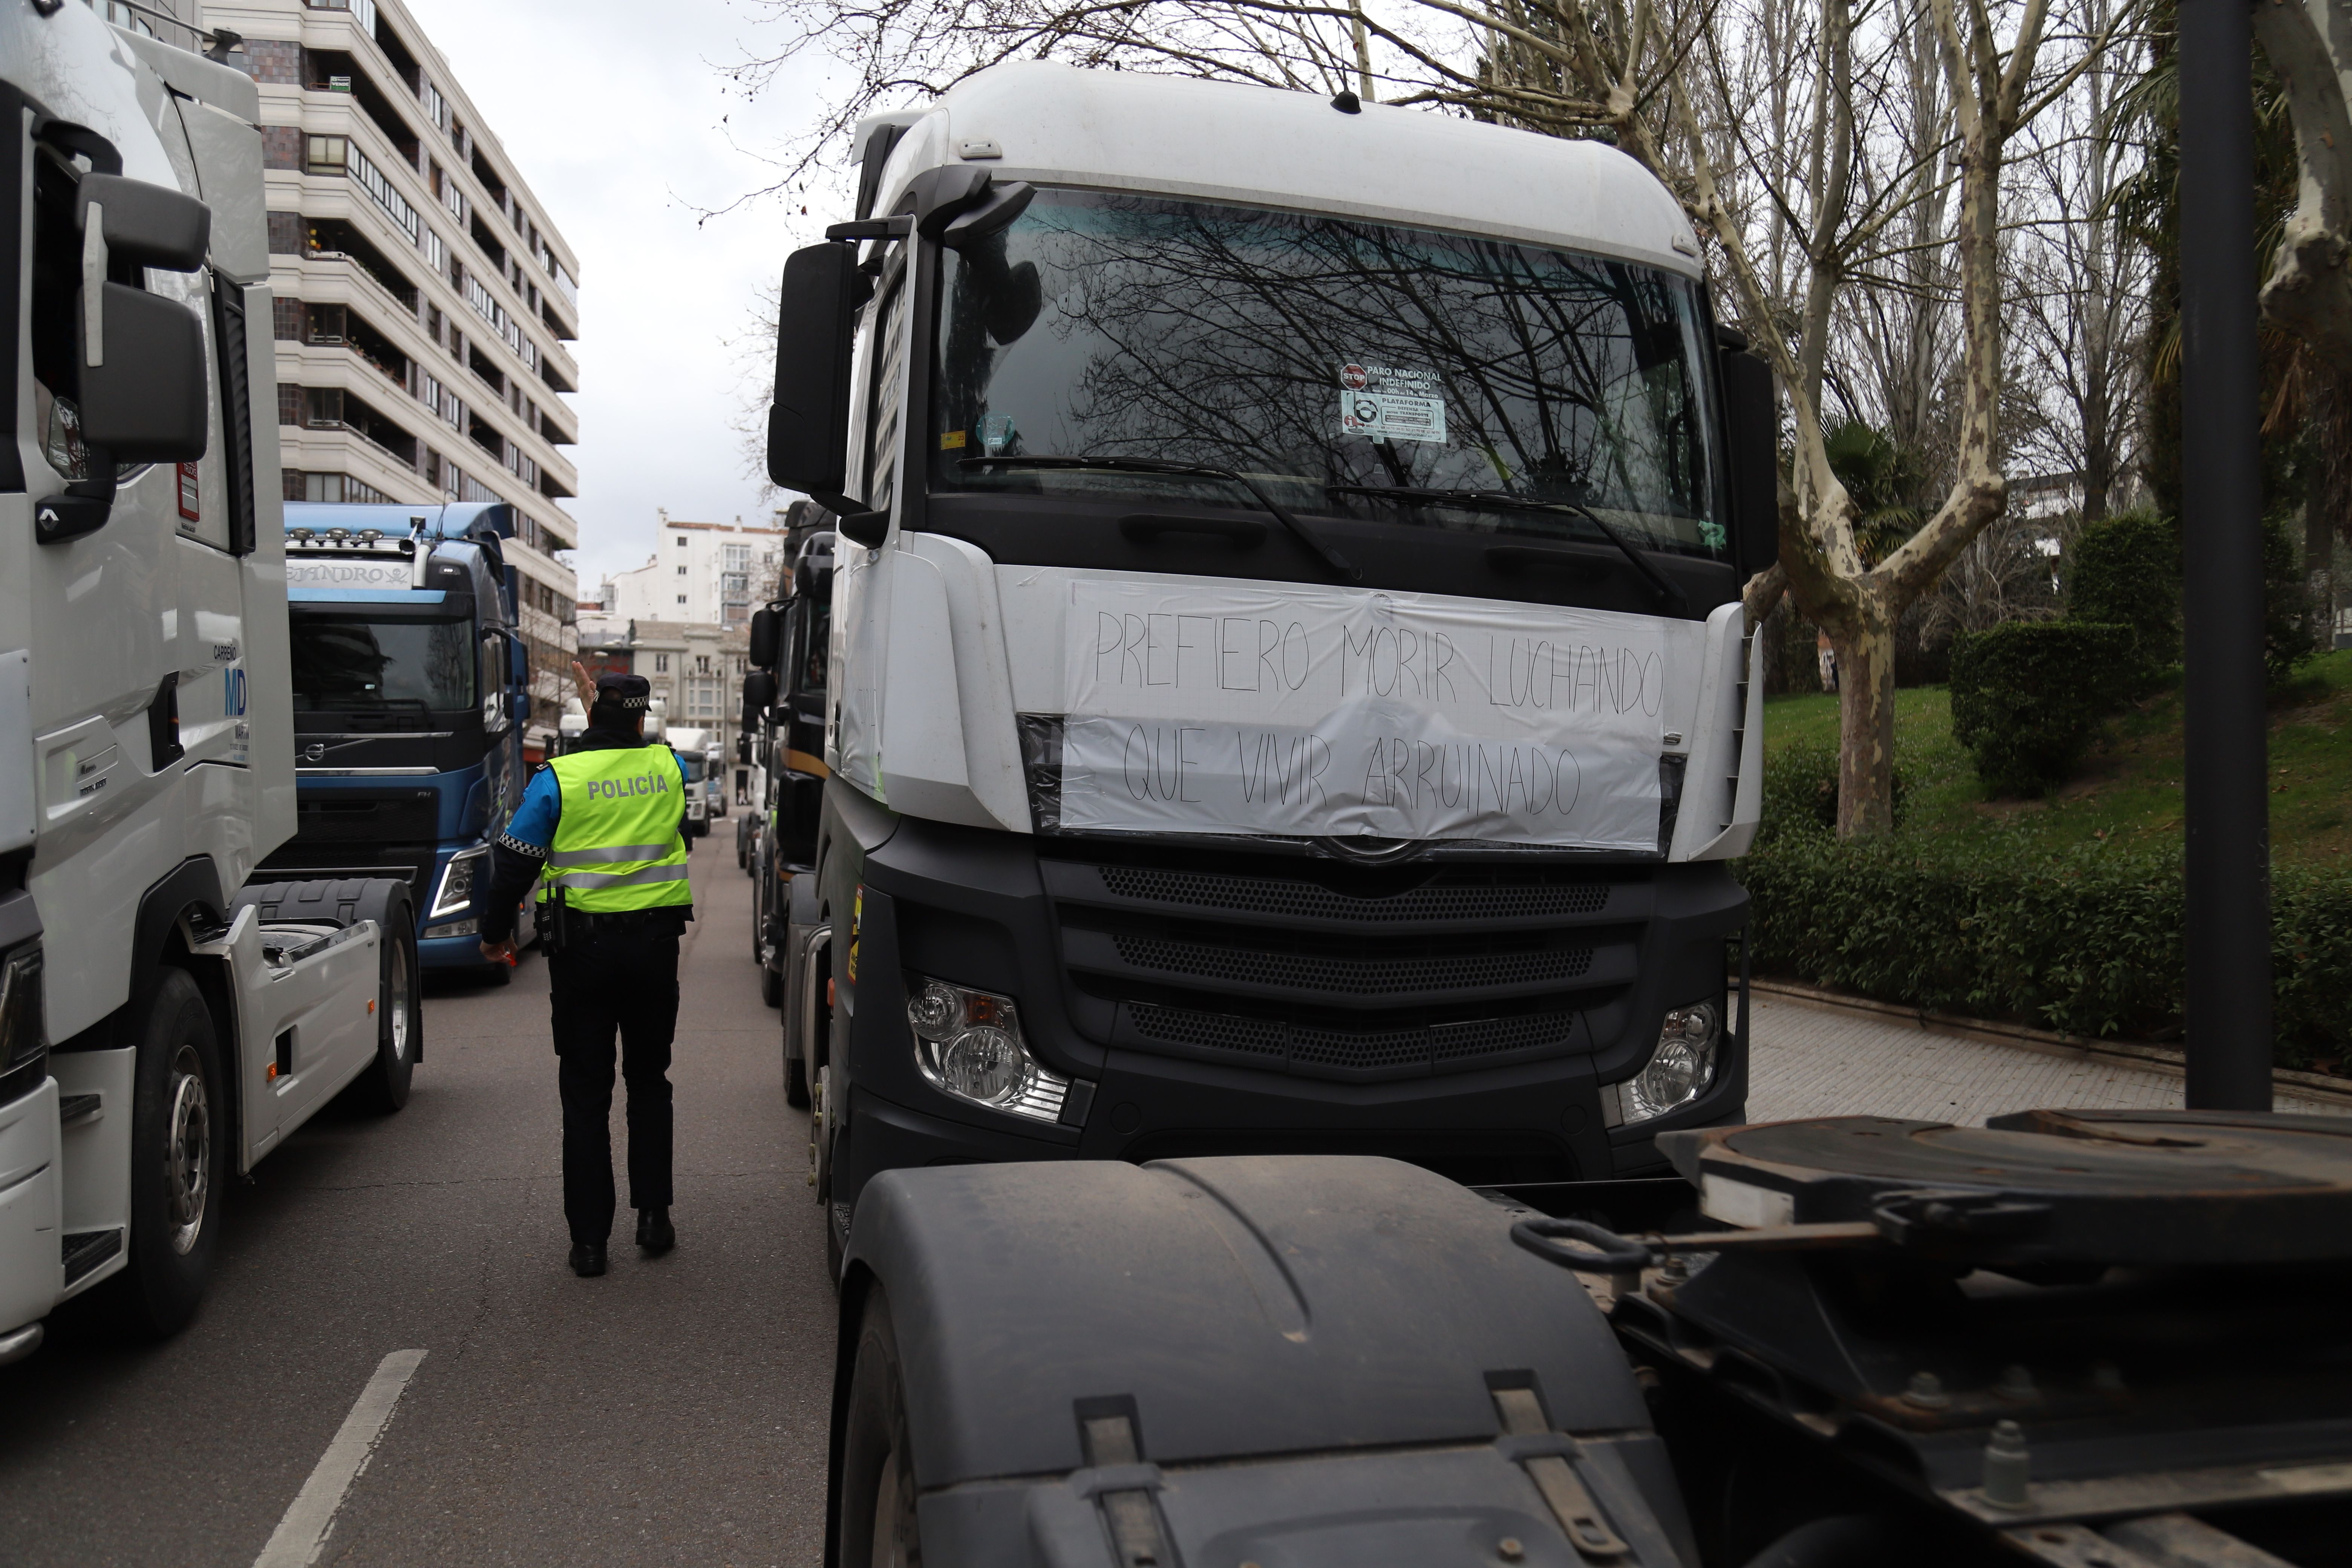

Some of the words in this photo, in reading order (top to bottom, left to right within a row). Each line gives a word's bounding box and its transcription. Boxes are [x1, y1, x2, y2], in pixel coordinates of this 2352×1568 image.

[1367, 366, 1392, 376] PARO
[1395, 368, 1442, 381] NACIONAL
[1379, 377, 1430, 390] INDEFINIDO
[1382, 398, 1431, 407] PLATAFORMA
[183, 463, 197, 477] TRUCKS
[214, 644, 237, 660] CARREÑO
[1096, 611, 1309, 694] PREFIERO
[1342, 625, 1456, 703] MORIR
[1490, 635, 1663, 717] LUCHANDO
[225, 668, 246, 716] MD
[1124, 723, 1206, 802] QUE
[1238, 731, 1331, 807] VIVIR
[1361, 737, 1580, 817] ARRUINADO
[587, 770, 669, 800] POLICÍA
